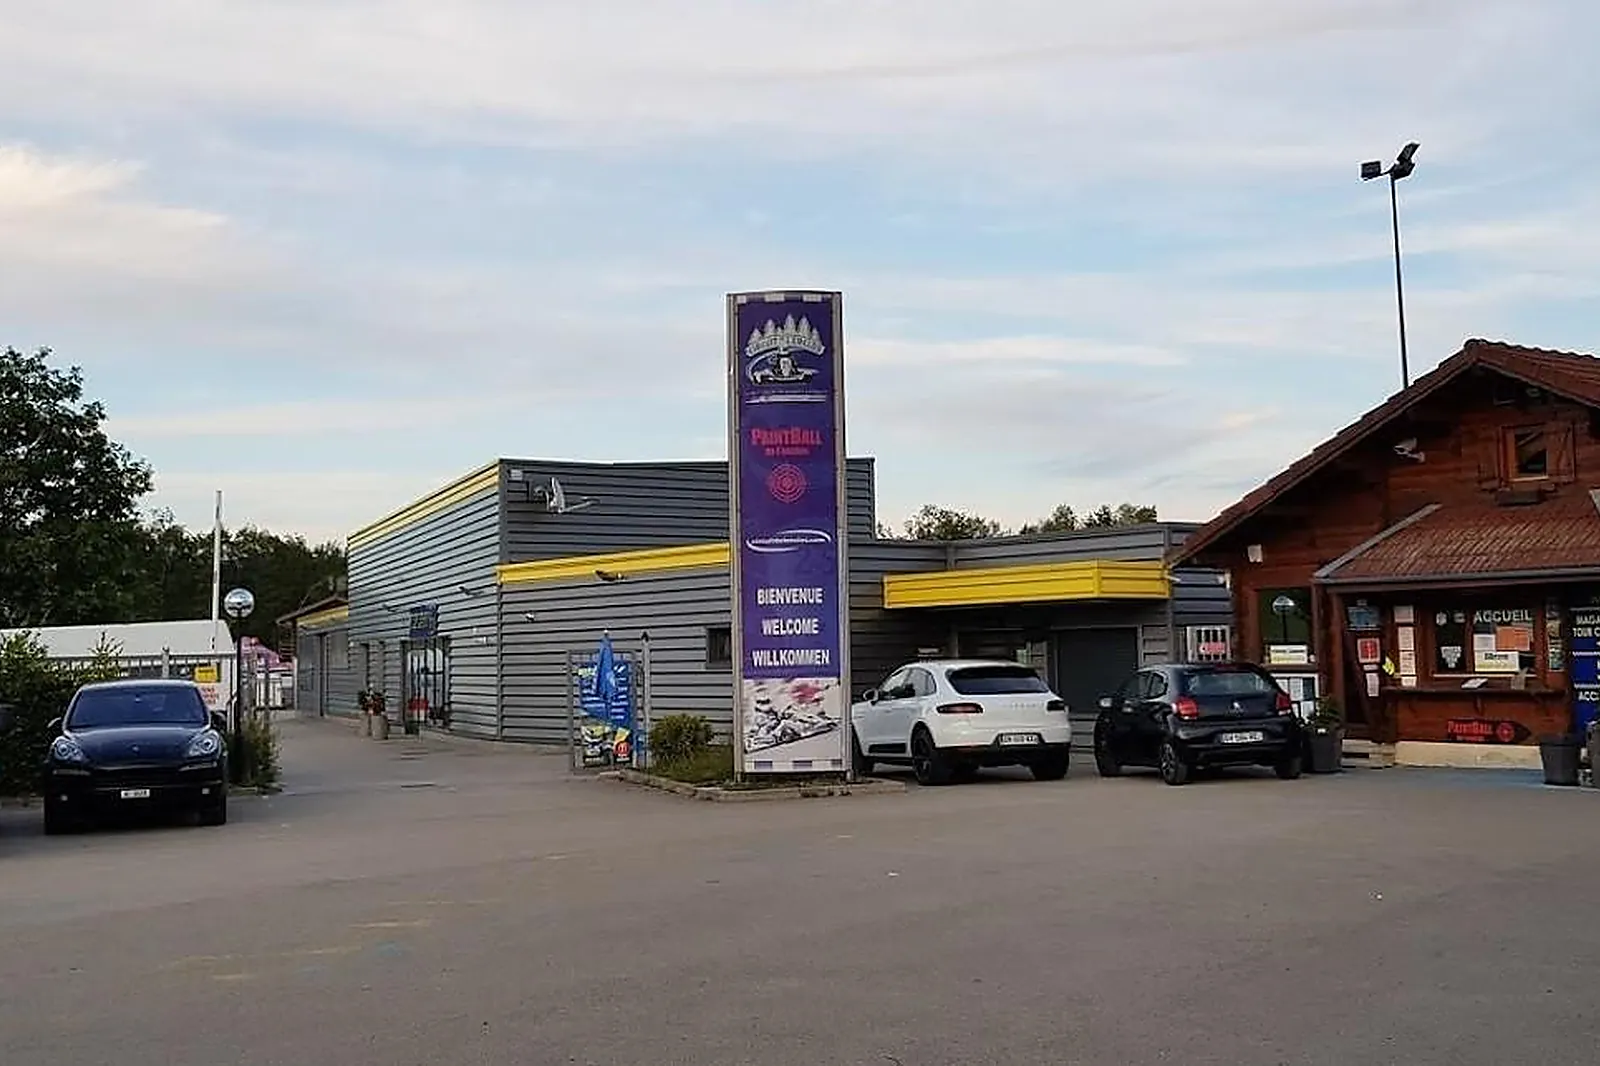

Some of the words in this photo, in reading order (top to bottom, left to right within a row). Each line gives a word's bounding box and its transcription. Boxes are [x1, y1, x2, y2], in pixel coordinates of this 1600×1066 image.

[757, 587, 823, 604] BIENVENUE
[1473, 609, 1532, 624] ACCUEIL
[762, 618, 819, 635] WELCOME
[752, 649, 830, 667] WILLKOMMEN
